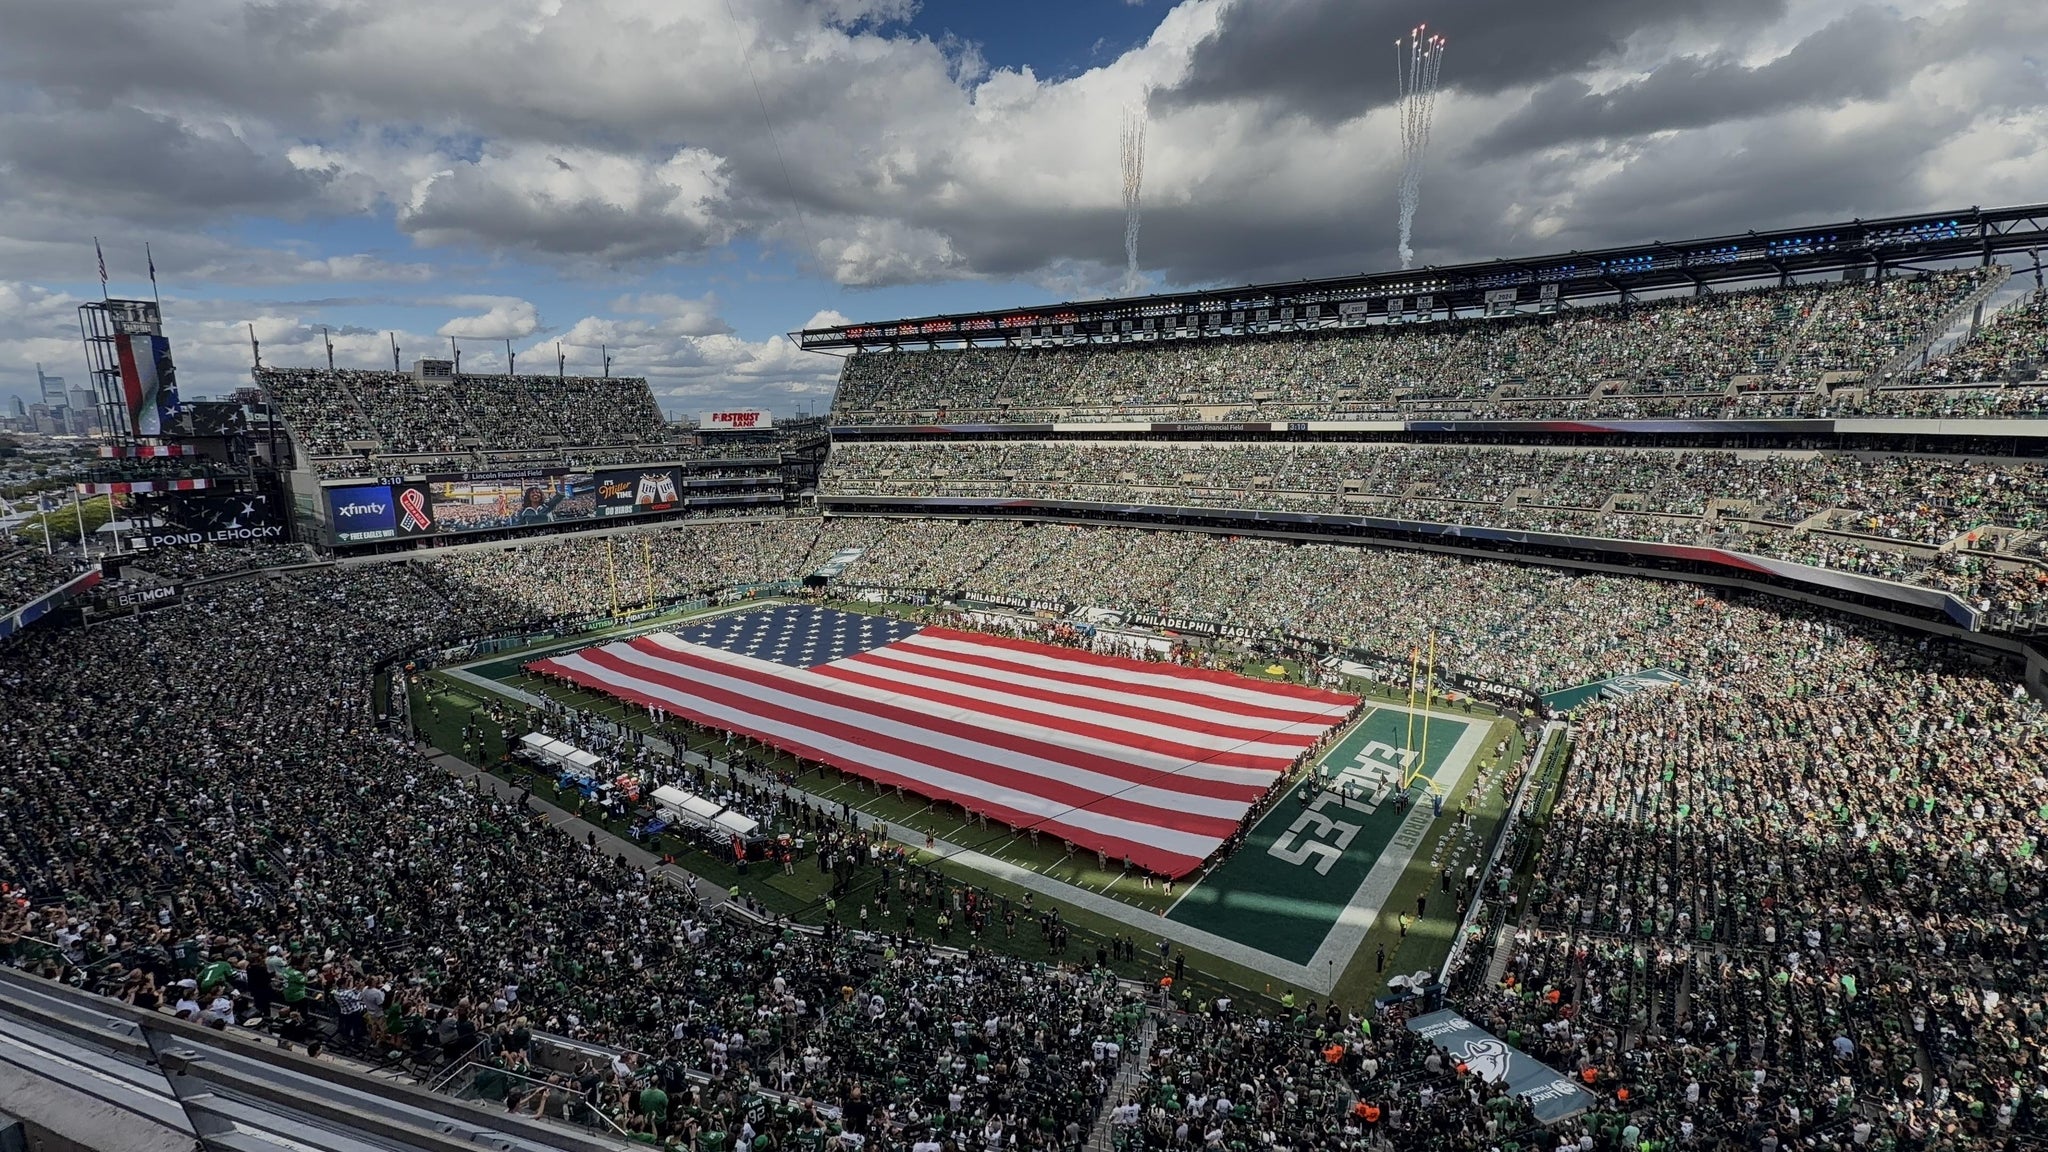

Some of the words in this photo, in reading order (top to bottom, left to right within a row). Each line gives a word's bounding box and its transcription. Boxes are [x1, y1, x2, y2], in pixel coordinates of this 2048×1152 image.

[712, 412, 760, 422] FRSTRUST
[381, 477, 402, 486] 3:10
[471, 472, 497, 480] Lincoln
[498, 470, 527, 478] Financial
[527, 469, 543, 477] Field
[598, 481, 632, 500] Miller
[616, 490, 633, 499] TIME
[641, 483, 656, 494] Lite
[660, 481, 673, 494] Lite
[339, 502, 386, 517] xfinity
[605, 506, 614, 516] GO
[614, 505, 633, 515] BIRDS
[152, 532, 201, 546] POND
[207, 526, 283, 542] LEHOCKY
[350, 532, 363, 541] FREE
[363, 530, 382, 539] EAGLES
[119, 586, 175, 606] BETMGM
[965, 592, 1027, 608] PHILADELPHIA
[1030, 600, 1066, 613] EAGLES
[588, 620, 613, 630] AUTISM
[1135, 614, 1216, 633] PHILADELPHIA
[1219, 626, 1267, 639] EAGLES
[1463, 680, 1478, 688] FLY
[1479, 681, 1523, 698] EAGLES
[1524, 694, 1534, 703] FLY
[1267, 740, 1420, 876] EAGLES
[1394, 810, 1433, 850] FORGET
[1531, 1090, 1563, 1106] Linco
[748, 1105, 766, 1124] 92
